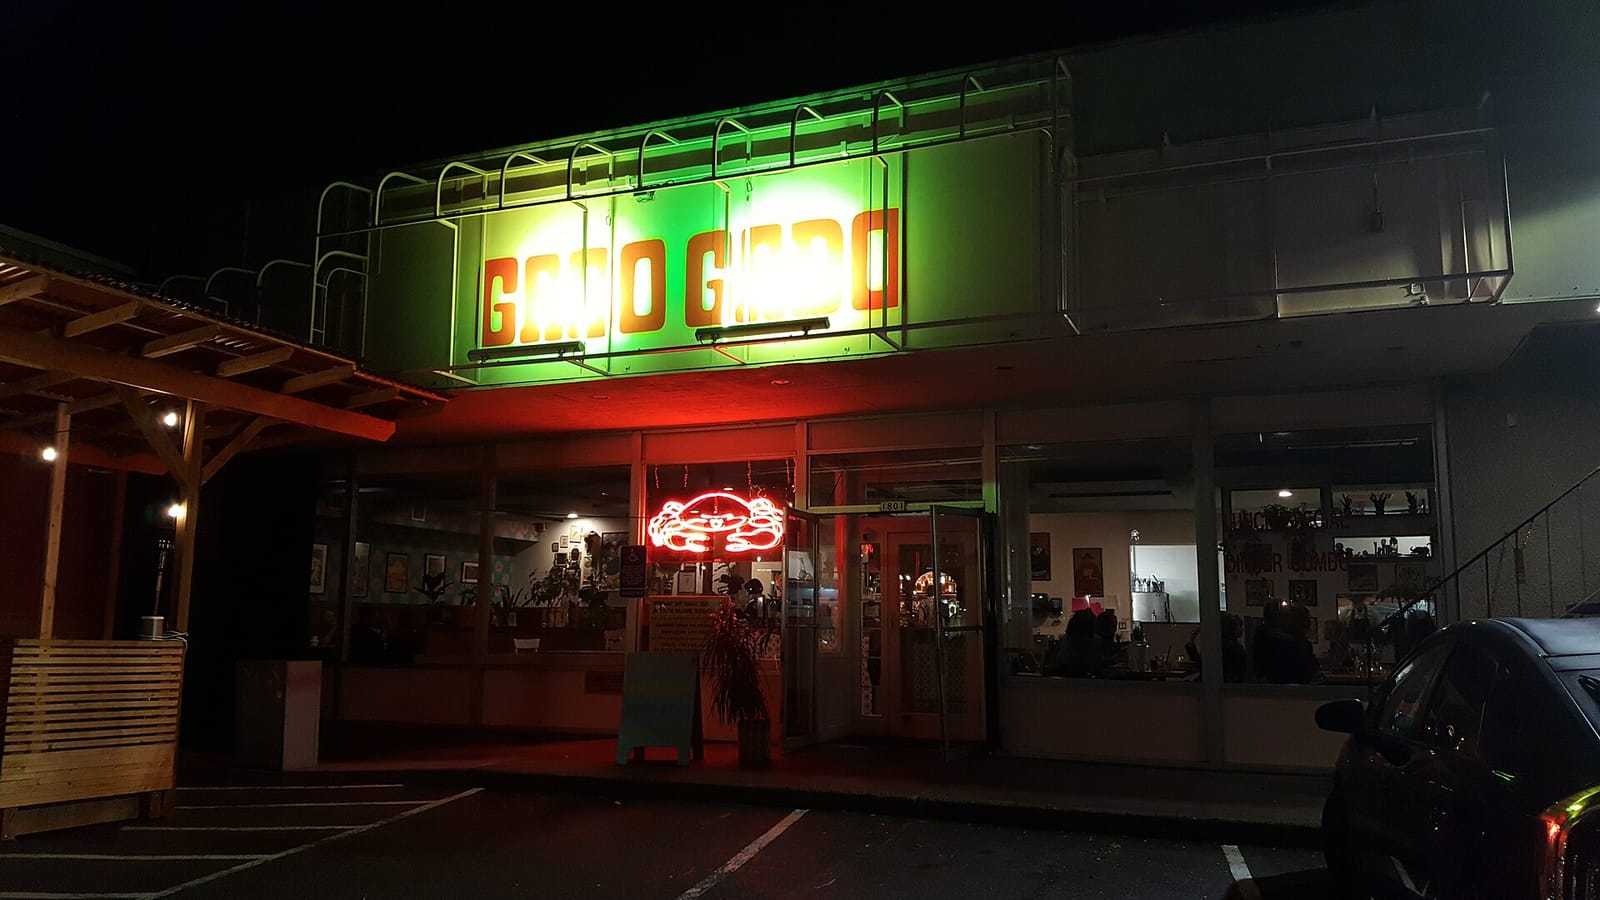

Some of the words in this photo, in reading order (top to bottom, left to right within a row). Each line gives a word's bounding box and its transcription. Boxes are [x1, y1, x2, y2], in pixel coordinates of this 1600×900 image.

[882, 502, 904, 511] 1801
[1227, 511, 1271, 530] UNCH
[1286, 511, 1350, 529] PECIAL
[1226, 552, 1283, 573] DINER
